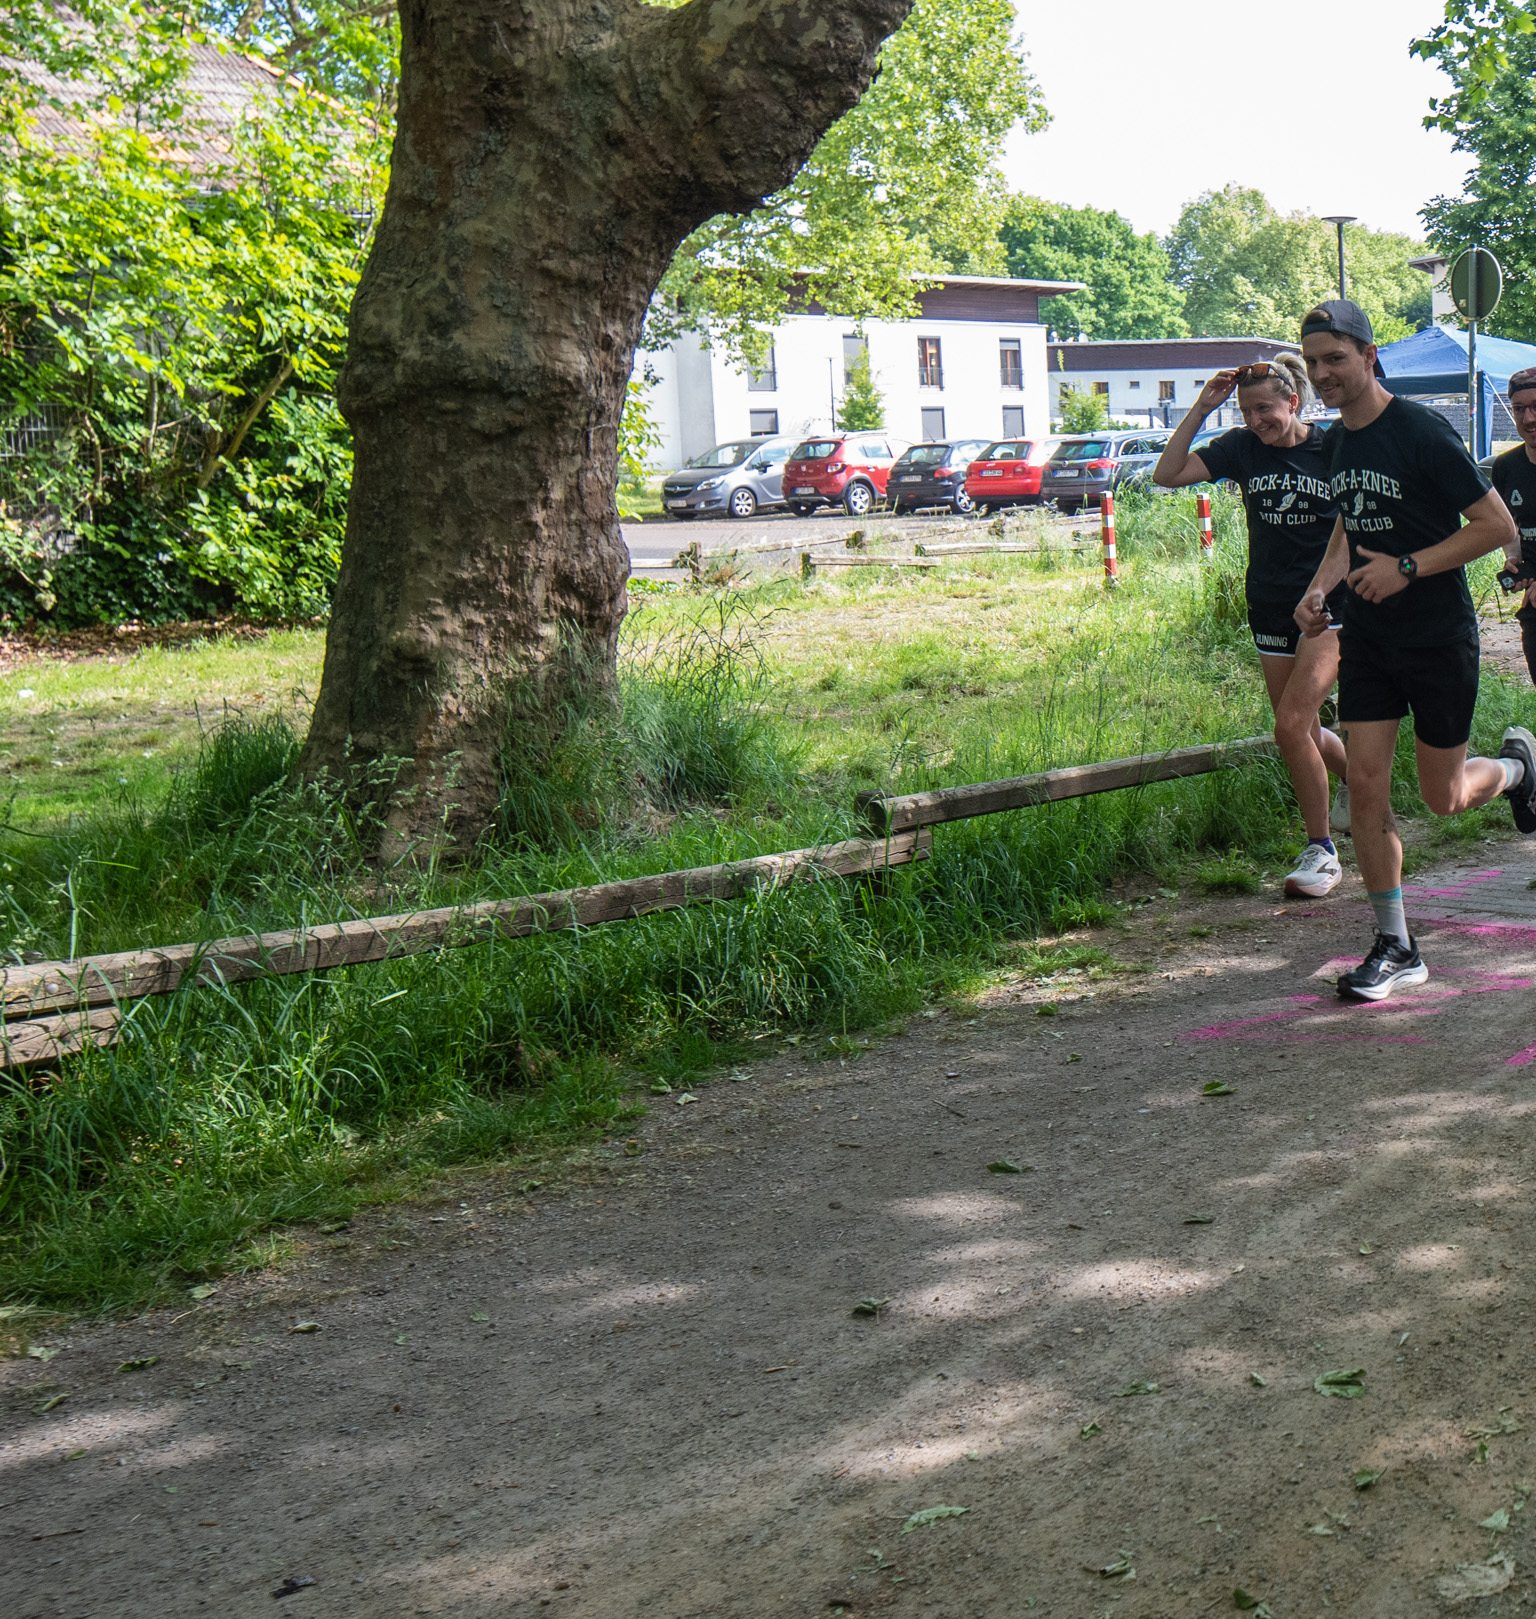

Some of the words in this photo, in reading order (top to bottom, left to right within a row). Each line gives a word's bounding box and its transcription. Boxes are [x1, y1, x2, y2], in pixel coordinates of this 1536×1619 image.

[1330, 468, 1402, 500] OCK-A-KNEE
[1262, 498, 1273, 507] 18
[1298, 501, 1309, 509] 98
[1366, 501, 1377, 510] 98
[1287, 514, 1317, 525] CLUB
[1345, 517, 1360, 531] RUN
[1361, 516, 1394, 532] CLUB
[1256, 633, 1288, 647] RUNNING
